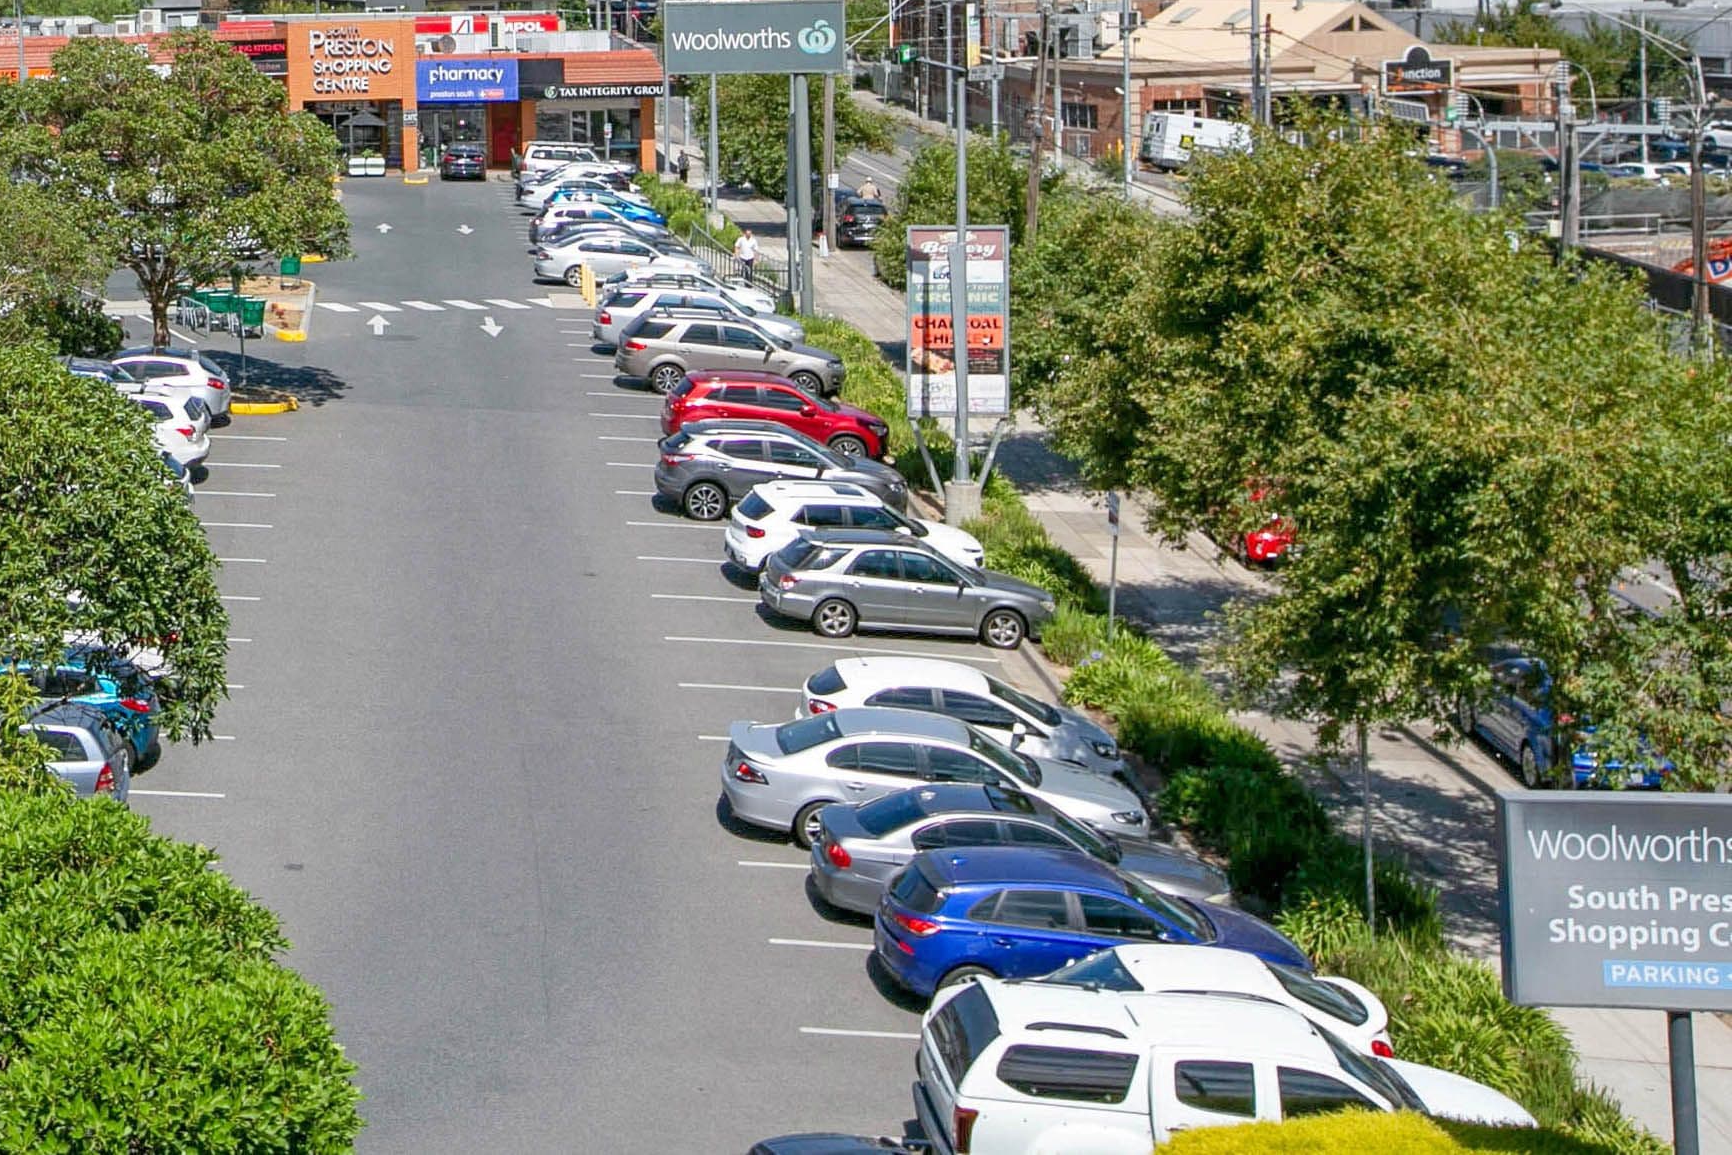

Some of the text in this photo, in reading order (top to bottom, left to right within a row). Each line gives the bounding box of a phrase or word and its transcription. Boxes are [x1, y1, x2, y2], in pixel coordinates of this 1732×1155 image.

[309, 30, 394, 57] PRESTON
[672, 27, 791, 51] Woolworths
[314, 59, 393, 76] SHOPPING
[429, 66, 504, 85] pharmacy
[314, 77, 369, 94] CENTRE
[559, 85, 664, 97] TAX INTEGRITY GROU
[920, 241, 996, 256] Baery
[915, 292, 999, 302] ORGNIC
[915, 318, 1002, 329] CHAOAL
[923, 334, 993, 345] CHIEN
[1568, 885, 1660, 911] South
[1549, 918, 1732, 953] Shopping C
[1611, 964, 1720, 985] PARKING
